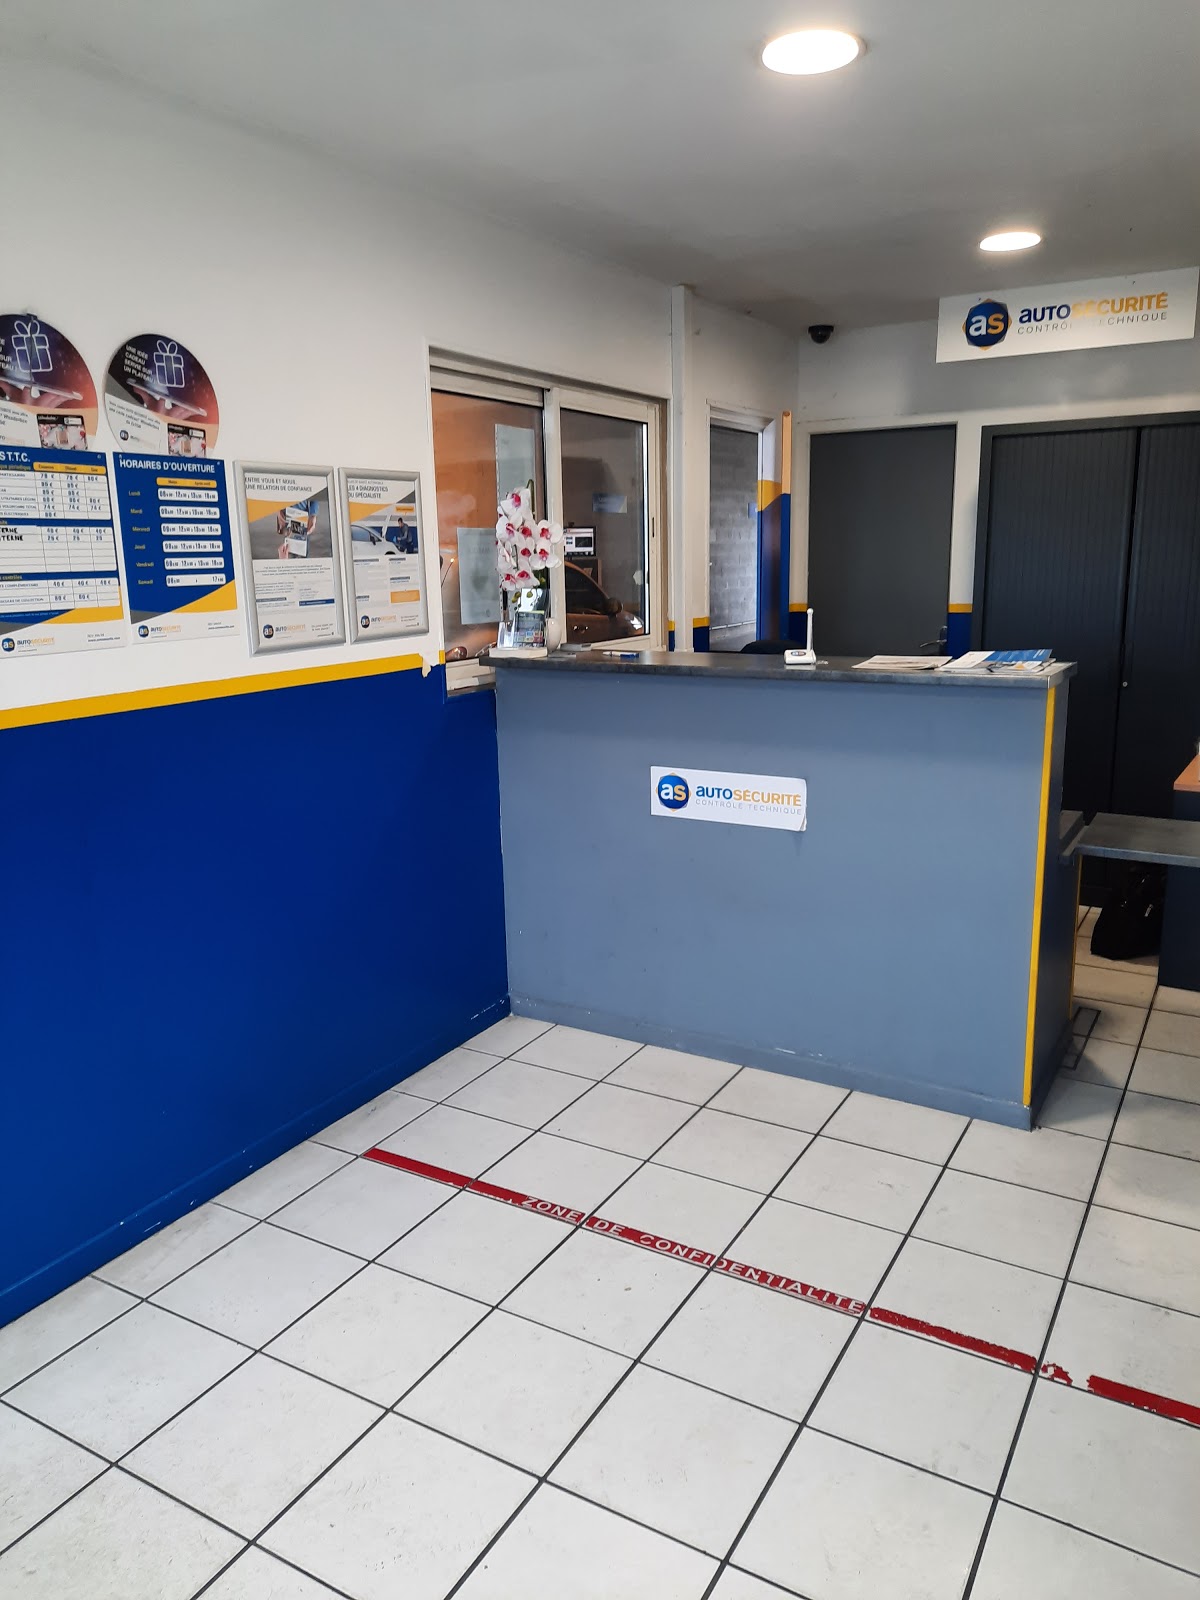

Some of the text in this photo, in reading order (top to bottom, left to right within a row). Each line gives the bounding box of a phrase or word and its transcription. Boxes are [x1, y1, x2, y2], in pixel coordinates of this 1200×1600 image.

[969, 313, 1005, 337] as
[125, 353, 146, 365] CADEAU
[120, 459, 215, 473] HORAIRES D'OUVERTURE
[660, 783, 686, 801] as
[696, 799, 801, 815] CONTRÔLE TECHNIQUE
[522, 1196, 582, 1222] ZONE
[594, 1220, 626, 1236] DE
